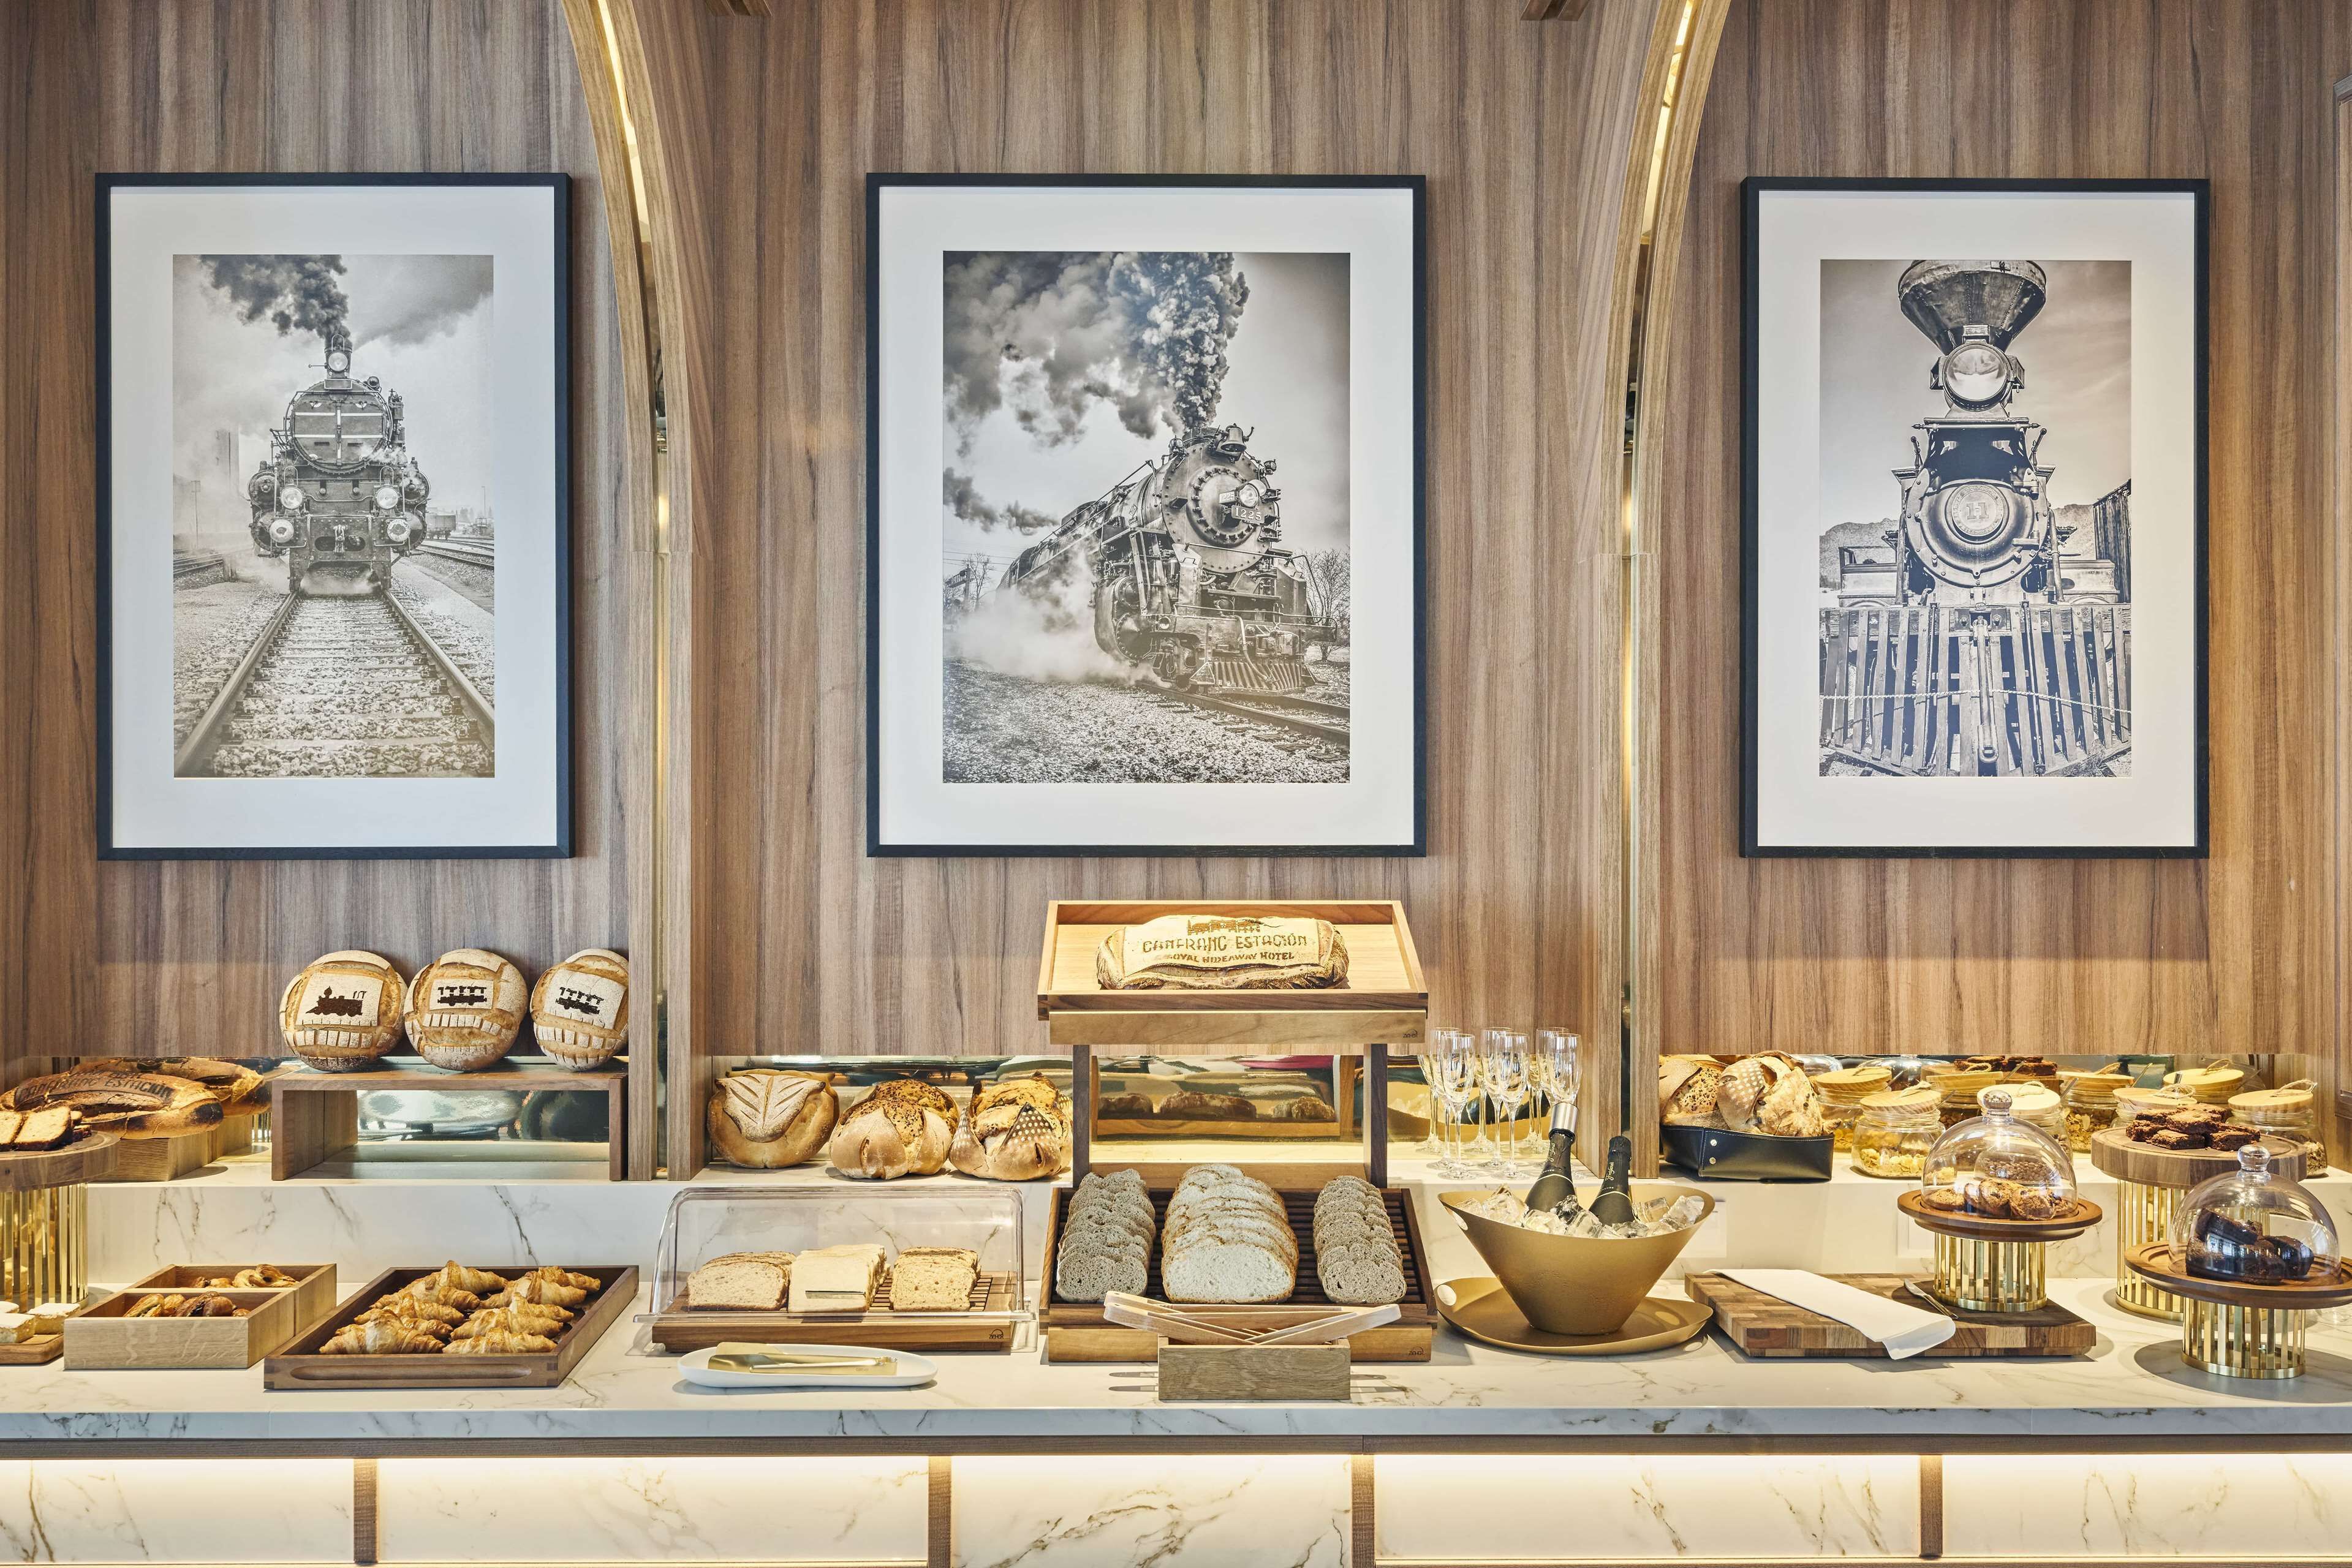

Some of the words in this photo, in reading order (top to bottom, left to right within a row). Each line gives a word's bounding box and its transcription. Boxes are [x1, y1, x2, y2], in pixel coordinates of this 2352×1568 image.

[1235, 507, 1262, 521] 1225
[1142, 935, 1227, 953] CANFRANC
[1235, 933, 1307, 949] ESTACIÓN
[1202, 953, 1257, 963] HIDEAWAY
[1260, 952, 1295, 960] HOTEL
